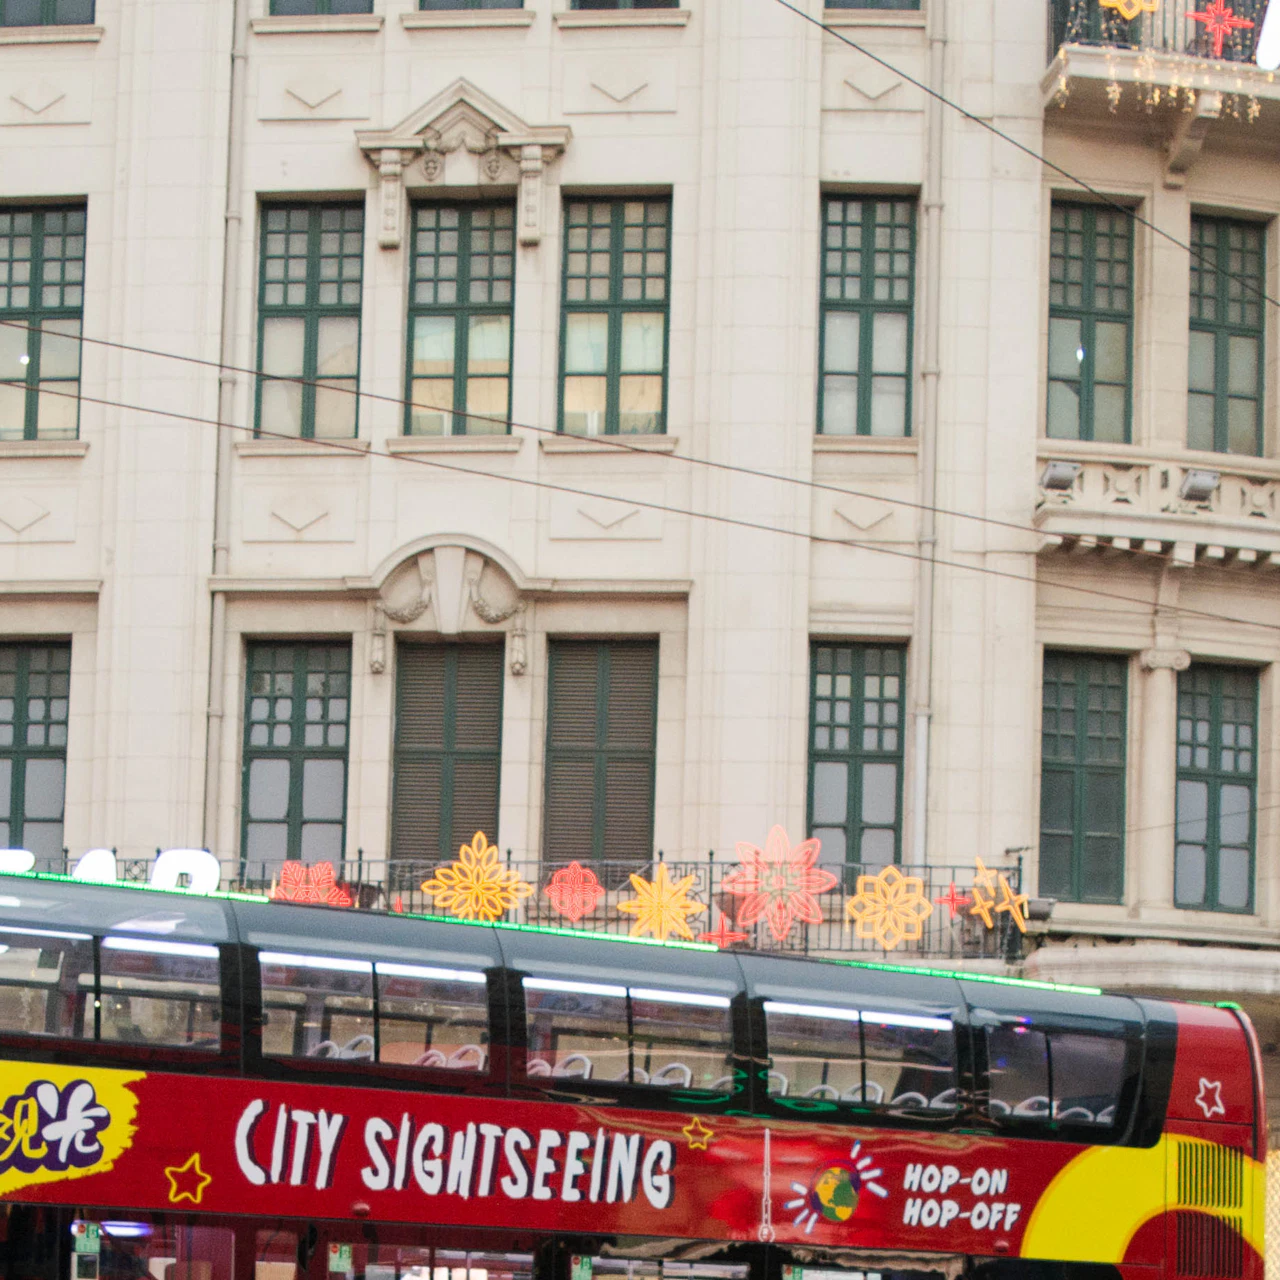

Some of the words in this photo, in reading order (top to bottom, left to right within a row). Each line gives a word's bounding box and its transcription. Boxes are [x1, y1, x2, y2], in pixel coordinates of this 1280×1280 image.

[234, 1098, 344, 1190] CITY
[360, 1112, 673, 1210] SIGHTSEEING
[903, 1163, 1008, 1196] HOP-ON
[902, 1197, 1022, 1232] HOP-OFF
